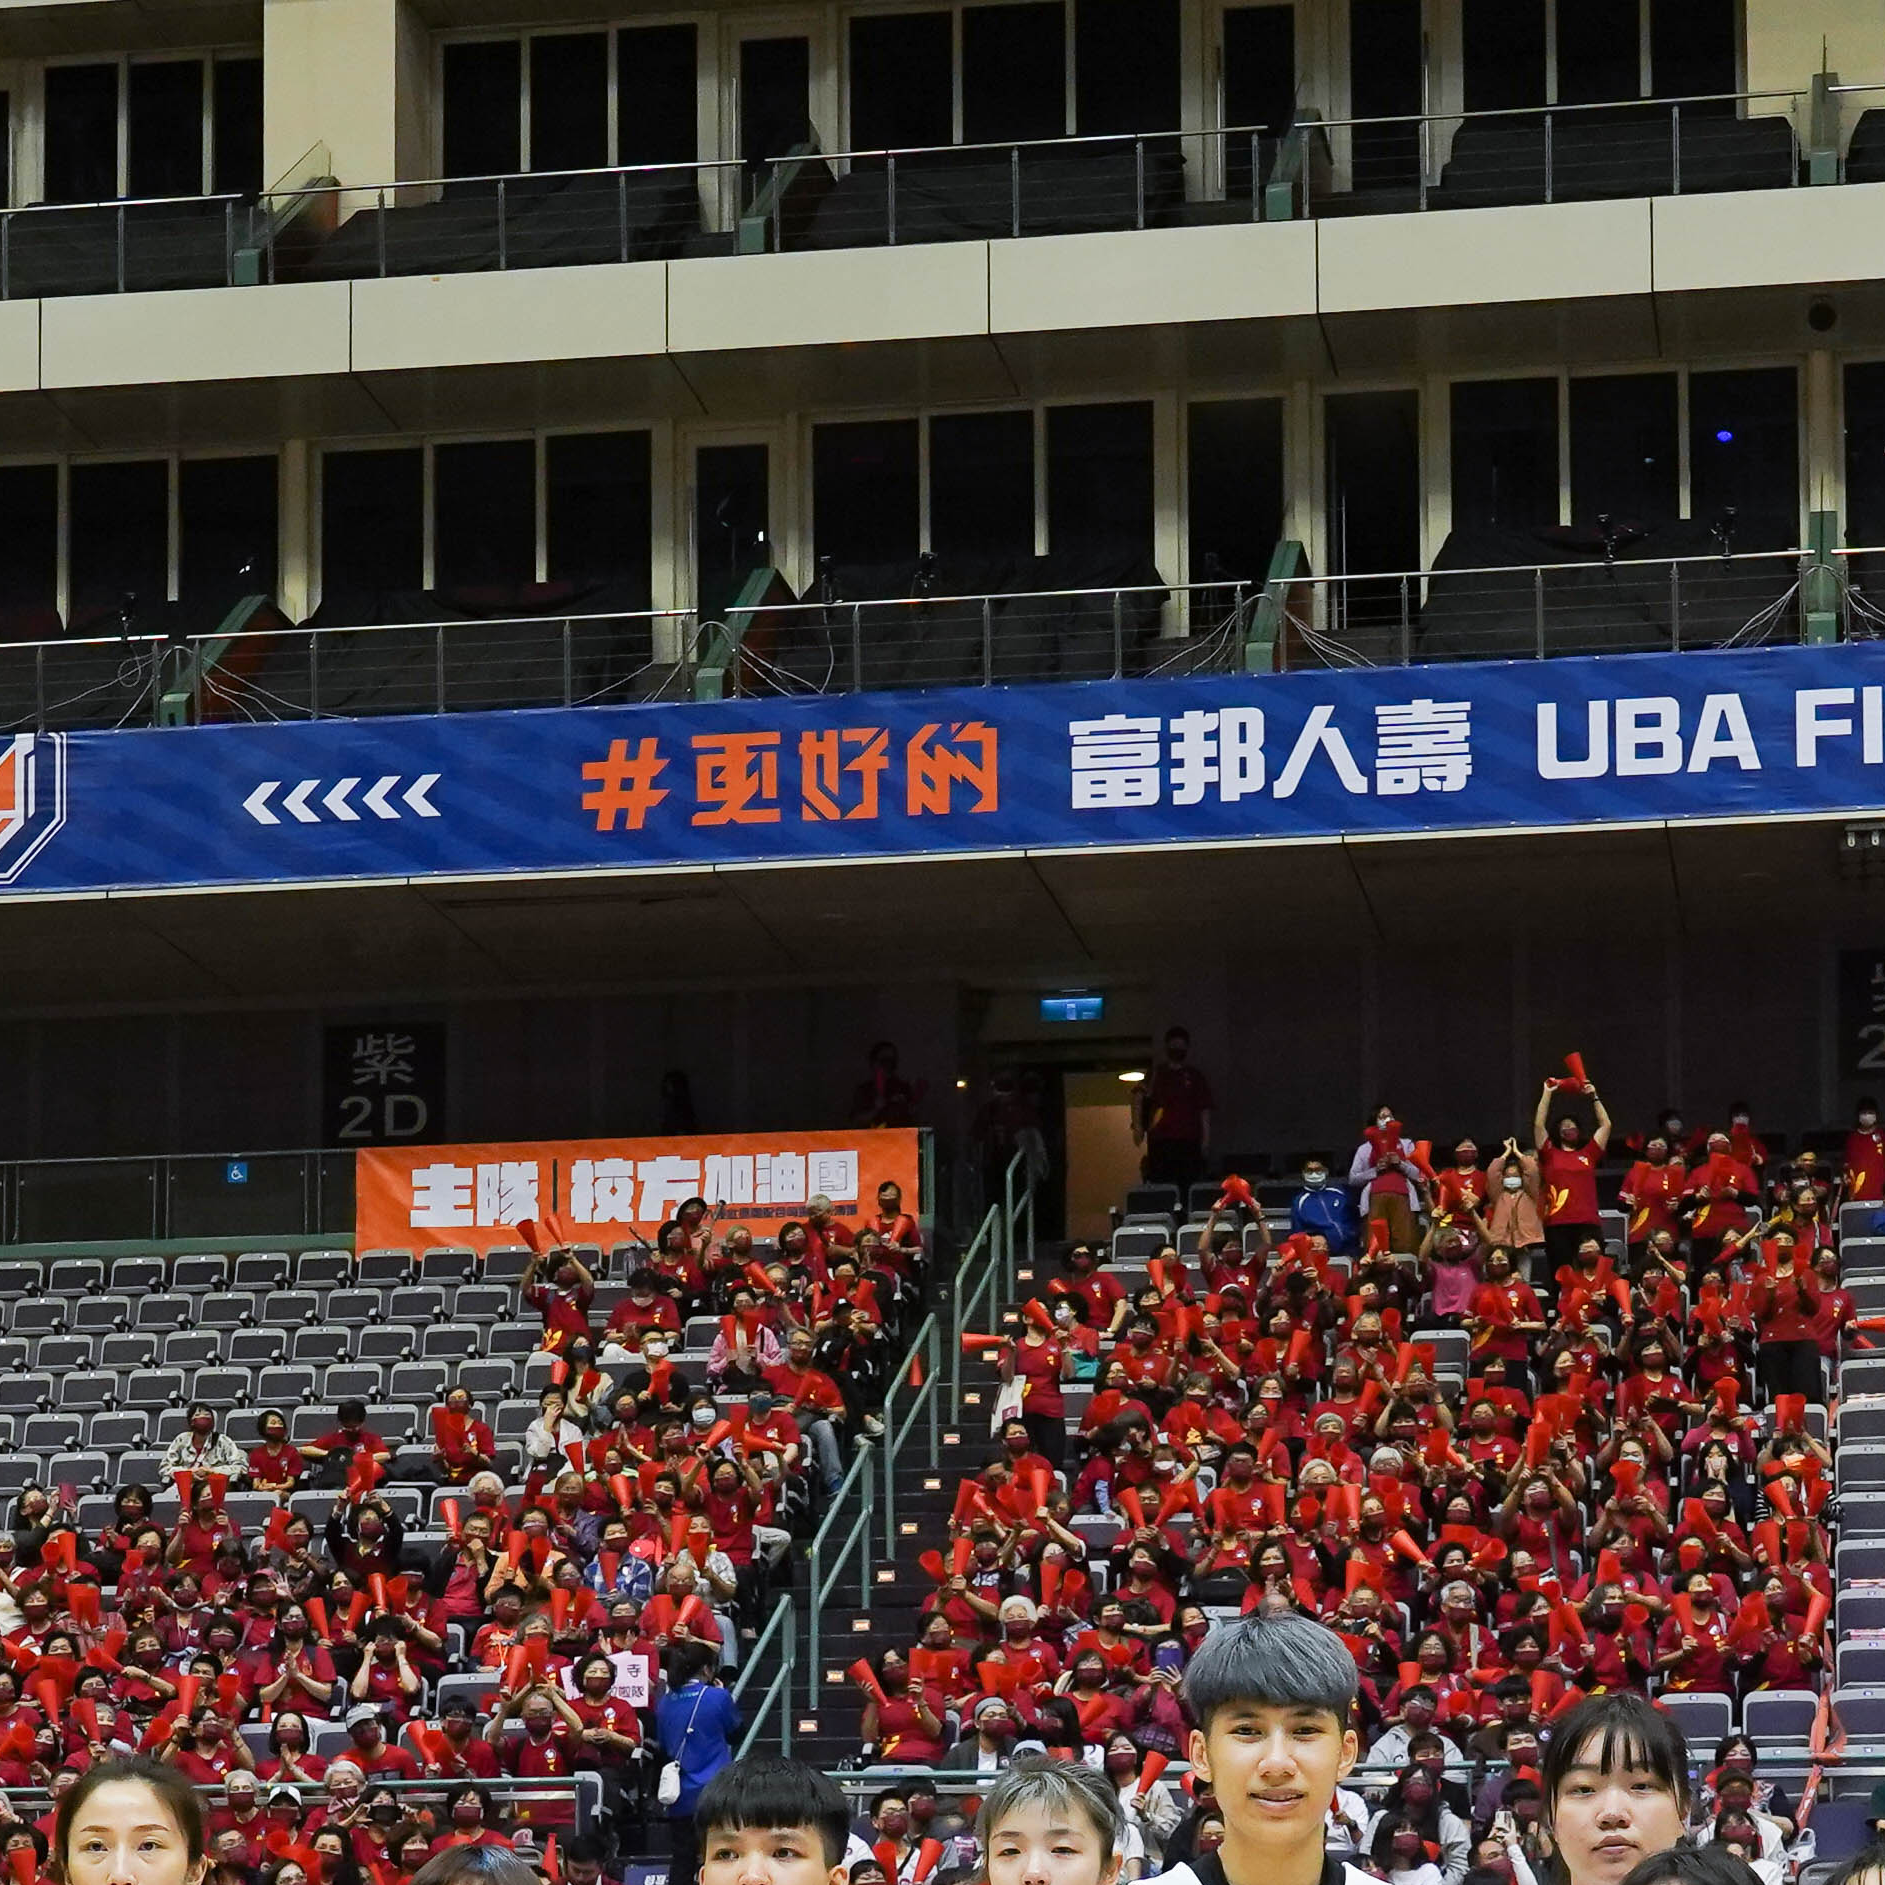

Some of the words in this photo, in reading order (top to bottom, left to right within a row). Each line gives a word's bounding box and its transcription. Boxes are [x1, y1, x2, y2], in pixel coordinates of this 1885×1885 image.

[580, 720, 1000, 830] #更好的
[1069, 699, 1474, 811] 富邦人壽
[1535, 692, 1761, 779] UBA
[352, 1032, 414, 1088] 紫
[337, 1095, 430, 1139] 2D
